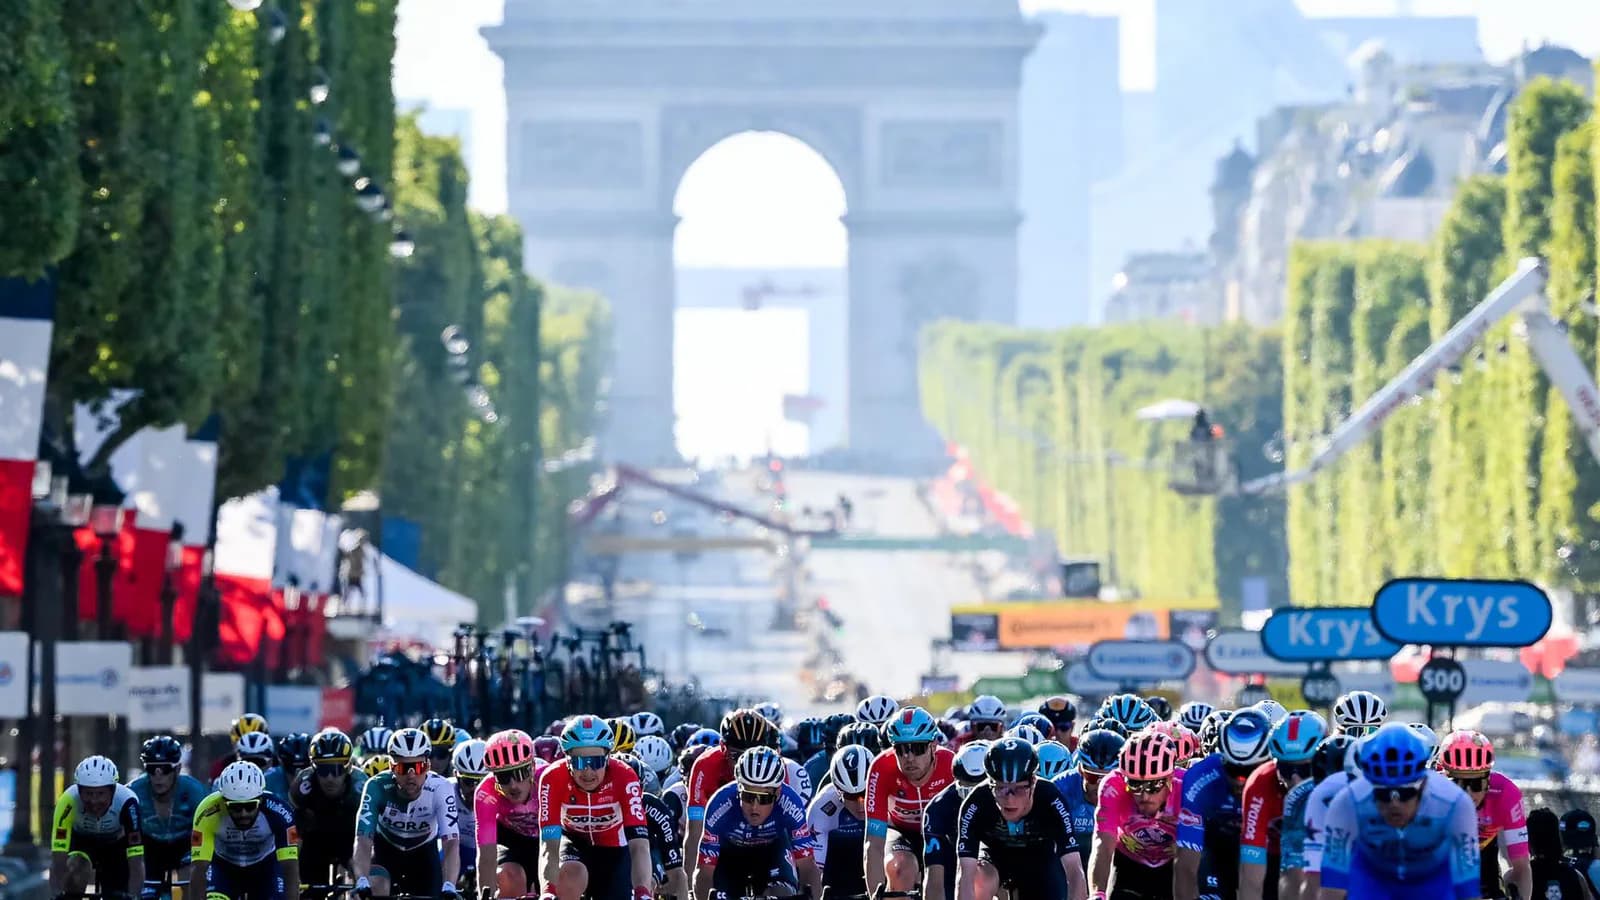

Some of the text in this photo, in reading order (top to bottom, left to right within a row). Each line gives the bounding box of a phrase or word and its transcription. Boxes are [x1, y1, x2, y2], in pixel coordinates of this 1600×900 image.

[1407, 584, 1519, 640] Krys
[1288, 613, 1380, 656] Krys
[1422, 669, 1463, 692] 500
[541, 783, 551, 822] SOUDAL
[780, 794, 804, 823] Alpecin
[867, 772, 880, 813] SOUDAL
[382, 816, 432, 832] BORA
[960, 803, 978, 840] youfone
[1073, 817, 1096, 827] ISRA
[1245, 796, 1264, 840] SOUDAL
